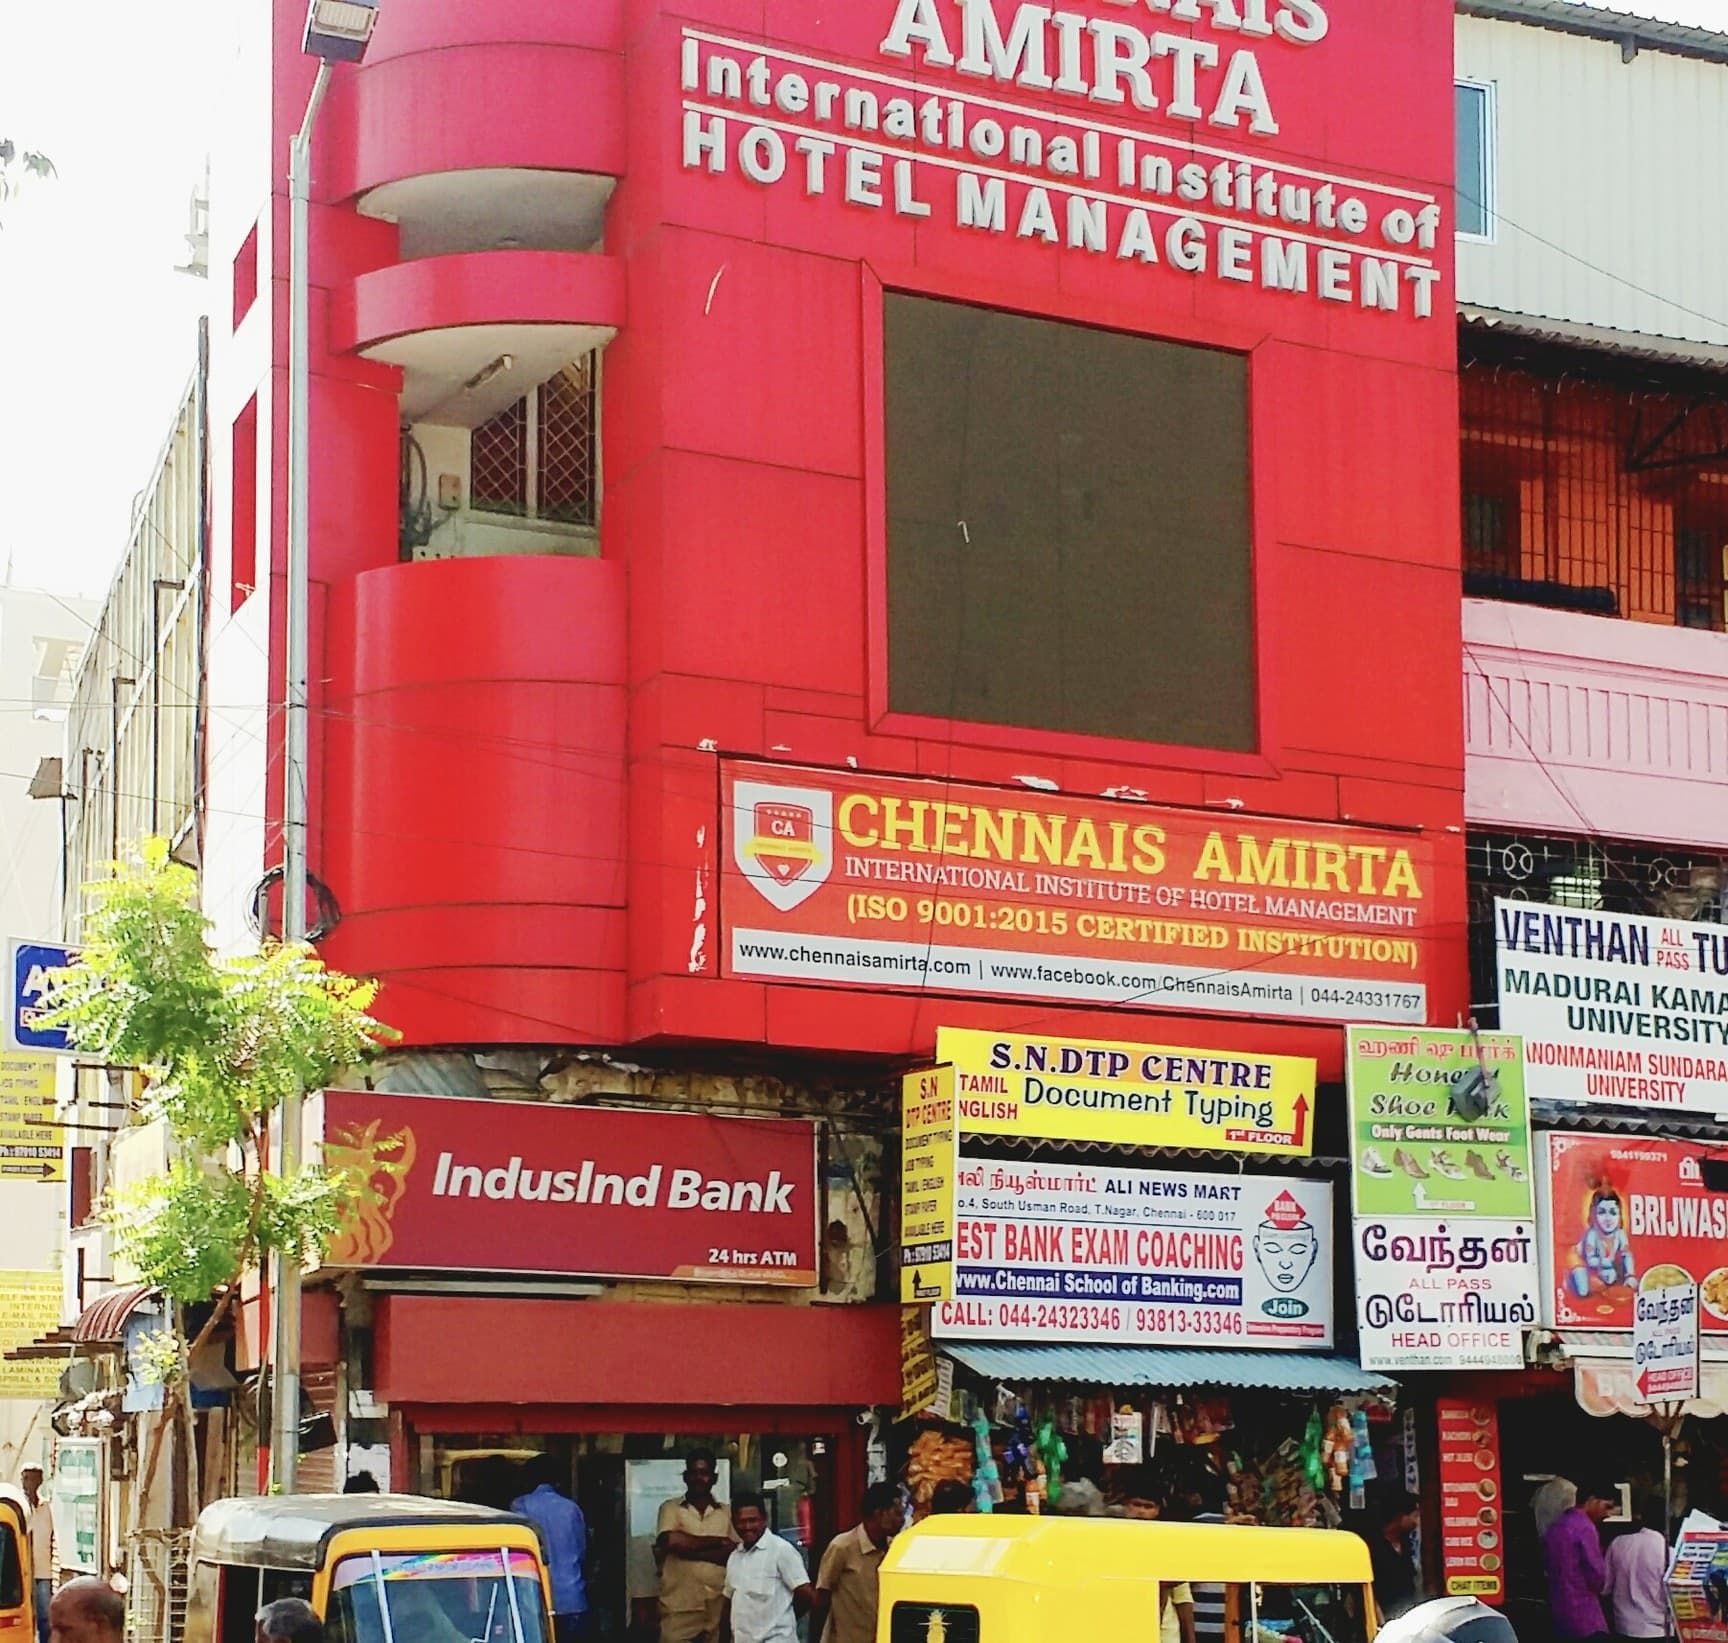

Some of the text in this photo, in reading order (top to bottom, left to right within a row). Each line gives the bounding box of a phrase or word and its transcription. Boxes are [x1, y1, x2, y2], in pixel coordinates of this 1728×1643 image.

[880, 0, 1279, 136] AMIRTA
[681, 38, 1441, 249] International Institute of
[683, 110, 1441, 319] HOTEL MANAGEMENT
[771, 820, 796, 837] CA
[838, 794, 1423, 899] CHENNAIS AMIRTA
[844, 856, 1418, 928] INTERNATIONAL INSTITUTE OF HOTEL MANAGEMENT
[847, 893, 1418, 970] (ISO 9001:2015 CERTIFIED INSTITUTION)
[1500, 908, 1649, 967] VENTHAN
[1660, 927, 1684, 948] ALL
[739, 942, 971, 976] www.chennaisamirta.com
[1656, 950, 1690, 971] PASS
[1310, 987, 1421, 1010] 044-24331767
[1505, 967, 1641, 1007] MADURAI
[1141, 1054, 1273, 1090] CENTRE
[1587, 1073, 1686, 1104] UNIVERSITY
[959, 1074, 1274, 1128] TAMIL Document Typing
[1371, 1094, 1436, 1116] Shoe
[1248, 1132, 1292, 1145] FLOOR
[1371, 1124, 1511, 1143] Only Gents Foot Wear
[432, 1152, 797, 1214] IndusInd Bank
[1104, 1179, 1242, 1201] ALI NEWS MART
[981, 1198, 1015, 1210] South
[1018, 1200, 1056, 1212] Usman
[1142, 1206, 1187, 1219] Chennai
[1196, 1209, 1215, 1221] 600
[1218, 1211, 1237, 1222] 017
[708, 1248, 797, 1266] 24 hrs ATM
[957, 1221, 1243, 1272] EST BANK EXAM COACHING
[1361, 1224, 1532, 1274] வேந்தன்
[1064, 1272, 1118, 1294] School
[1121, 1275, 1139, 1295] of
[1141, 1276, 1240, 1302] Banking.com
[1408, 1278, 1493, 1290] ALL PASS
[941, 1301, 993, 1326] CALL:
[999, 1303, 1121, 1331] 044-24323346
[1136, 1308, 1242, 1335] 93813-33346
[1267, 1300, 1304, 1315] Join
[1365, 1291, 1536, 1329] டுடோரியல்
[1391, 1332, 1512, 1348] HEAD OFFICE
